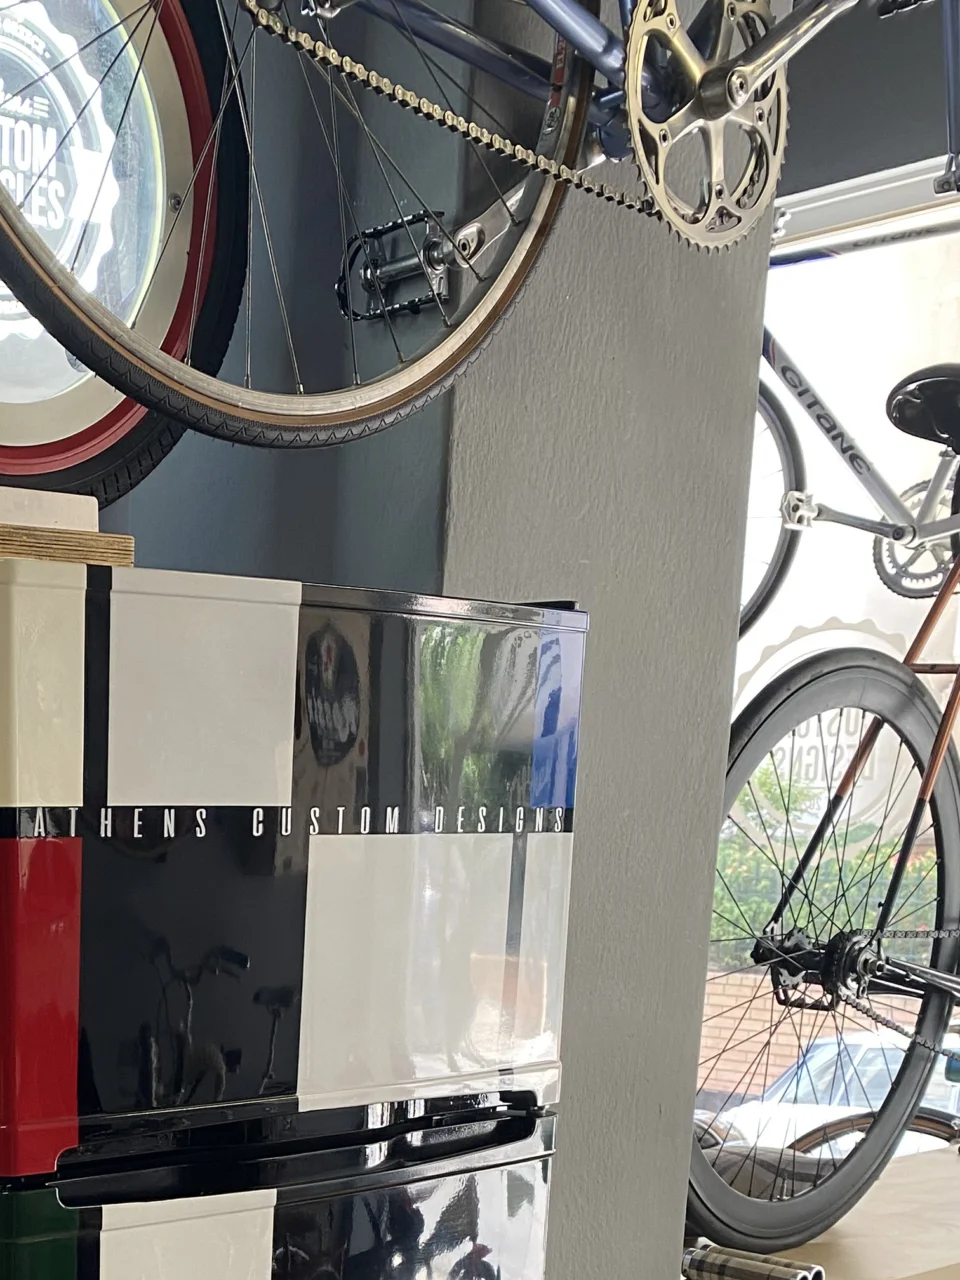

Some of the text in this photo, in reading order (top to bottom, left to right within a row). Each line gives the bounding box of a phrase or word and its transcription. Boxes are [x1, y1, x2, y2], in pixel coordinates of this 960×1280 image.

[34, 806, 563, 838] ATHENS CUSTOM DESIGNS
